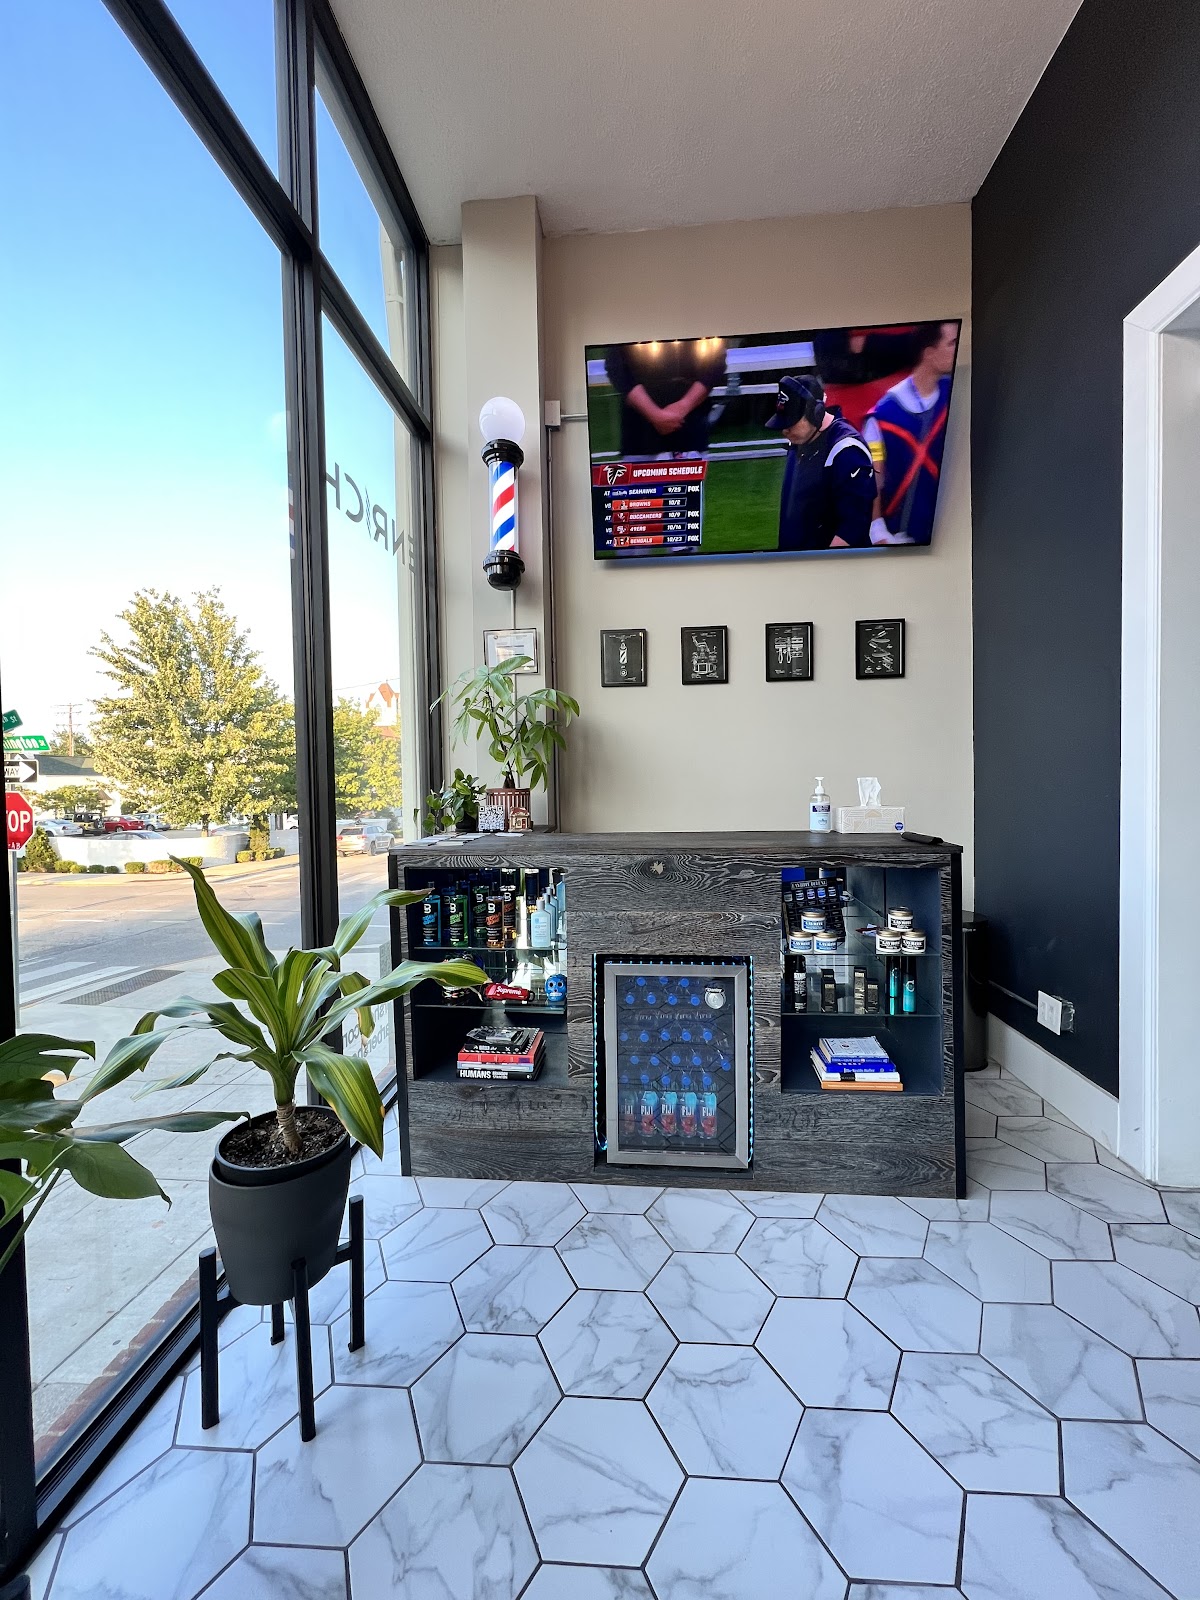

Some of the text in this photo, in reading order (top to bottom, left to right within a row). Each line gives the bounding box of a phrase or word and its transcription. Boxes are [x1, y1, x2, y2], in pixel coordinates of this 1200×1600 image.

[633, 466, 703, 477] UPCOMING SCHEDULE
[7, 810, 31, 833] OP
[496, 985, 522, 995] Supreme
[460, 1069, 492, 1079] HUMANS
[640, 1105, 653, 1115] FIJI
[661, 1104, 674, 1114] FIJI
[681, 1105, 695, 1116] FIJI
[702, 1106, 715, 1117] FIJI
